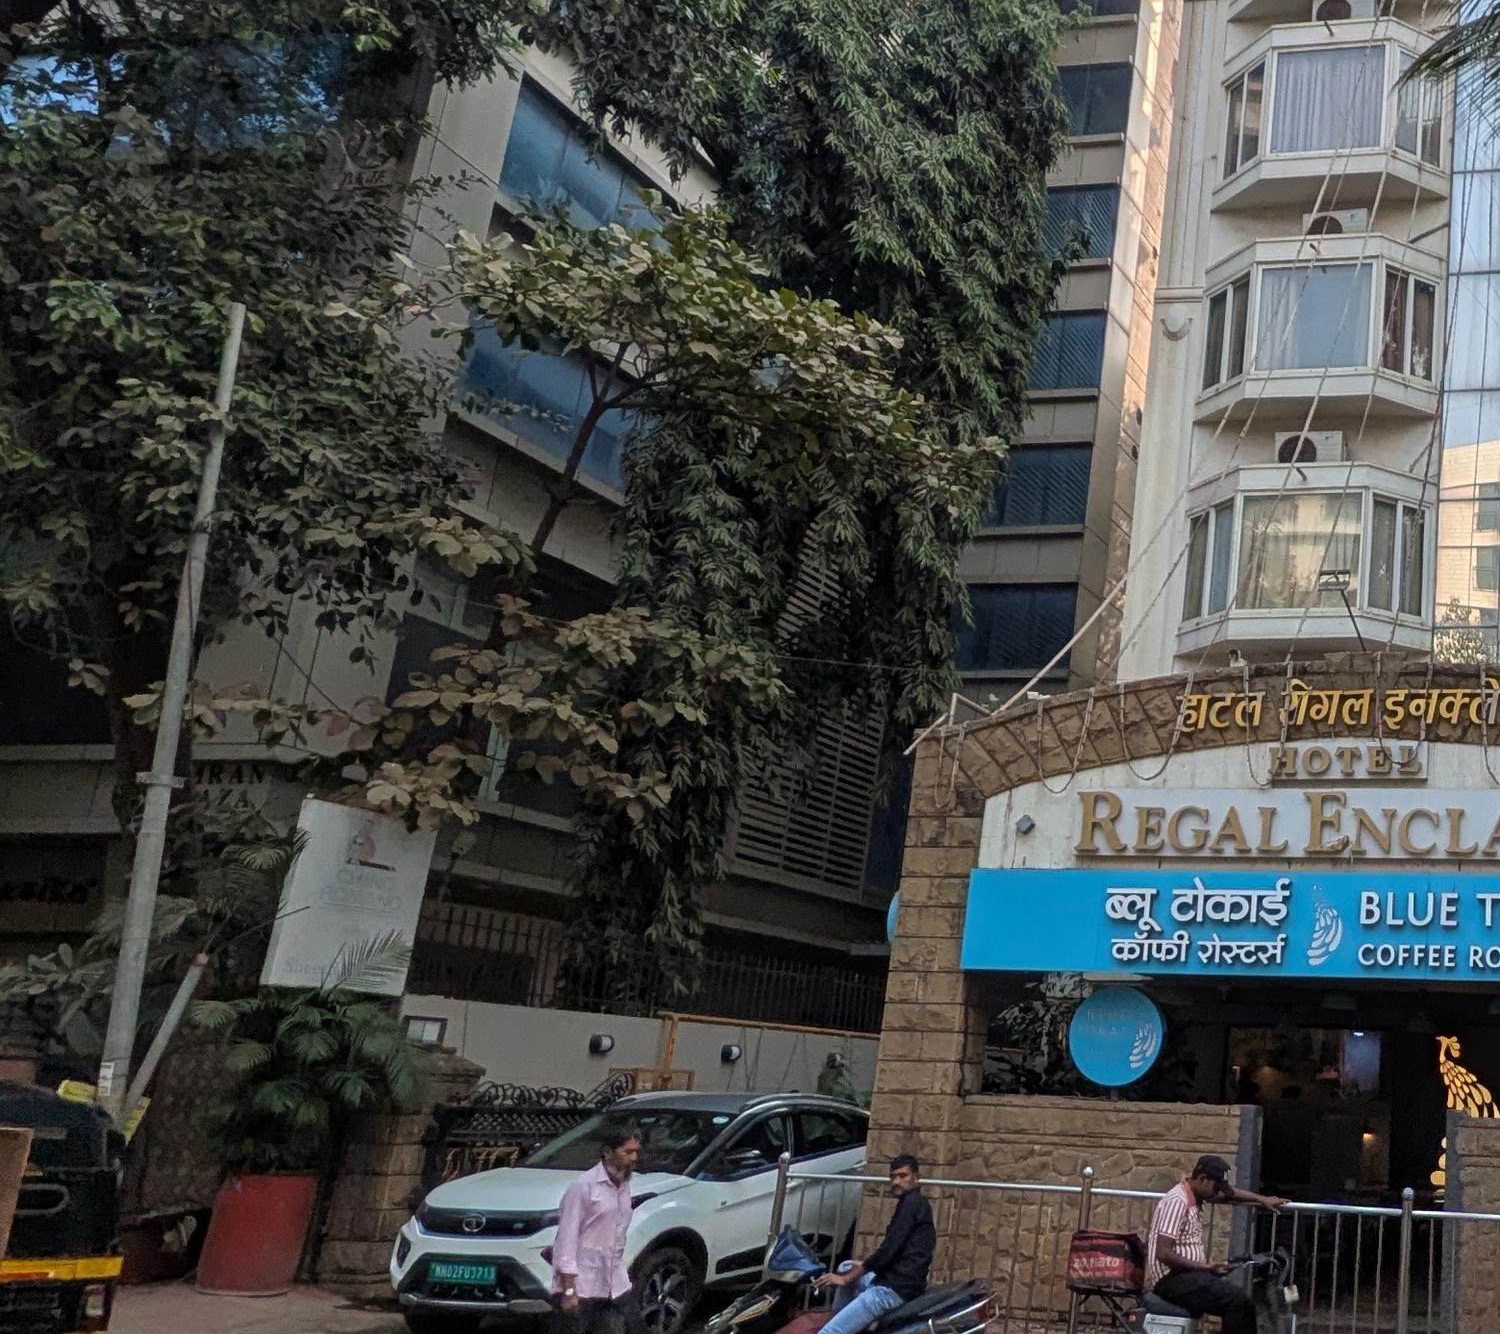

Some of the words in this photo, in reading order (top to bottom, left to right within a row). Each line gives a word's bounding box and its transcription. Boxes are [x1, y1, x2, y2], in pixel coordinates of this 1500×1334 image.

[1268, 746, 1423, 775] HOTEL
[1074, 790, 1288, 855] REGAL
[1105, 887, 1162, 931] ब्लू
[1170, 877, 1291, 926] टोकाई
[1359, 891, 1459, 927] BLUE
[1111, 930, 1189, 962] कॉफी
[1197, 933, 1287, 965] रोस्टर्स
[1358, 944, 1456, 968] COFFEE
